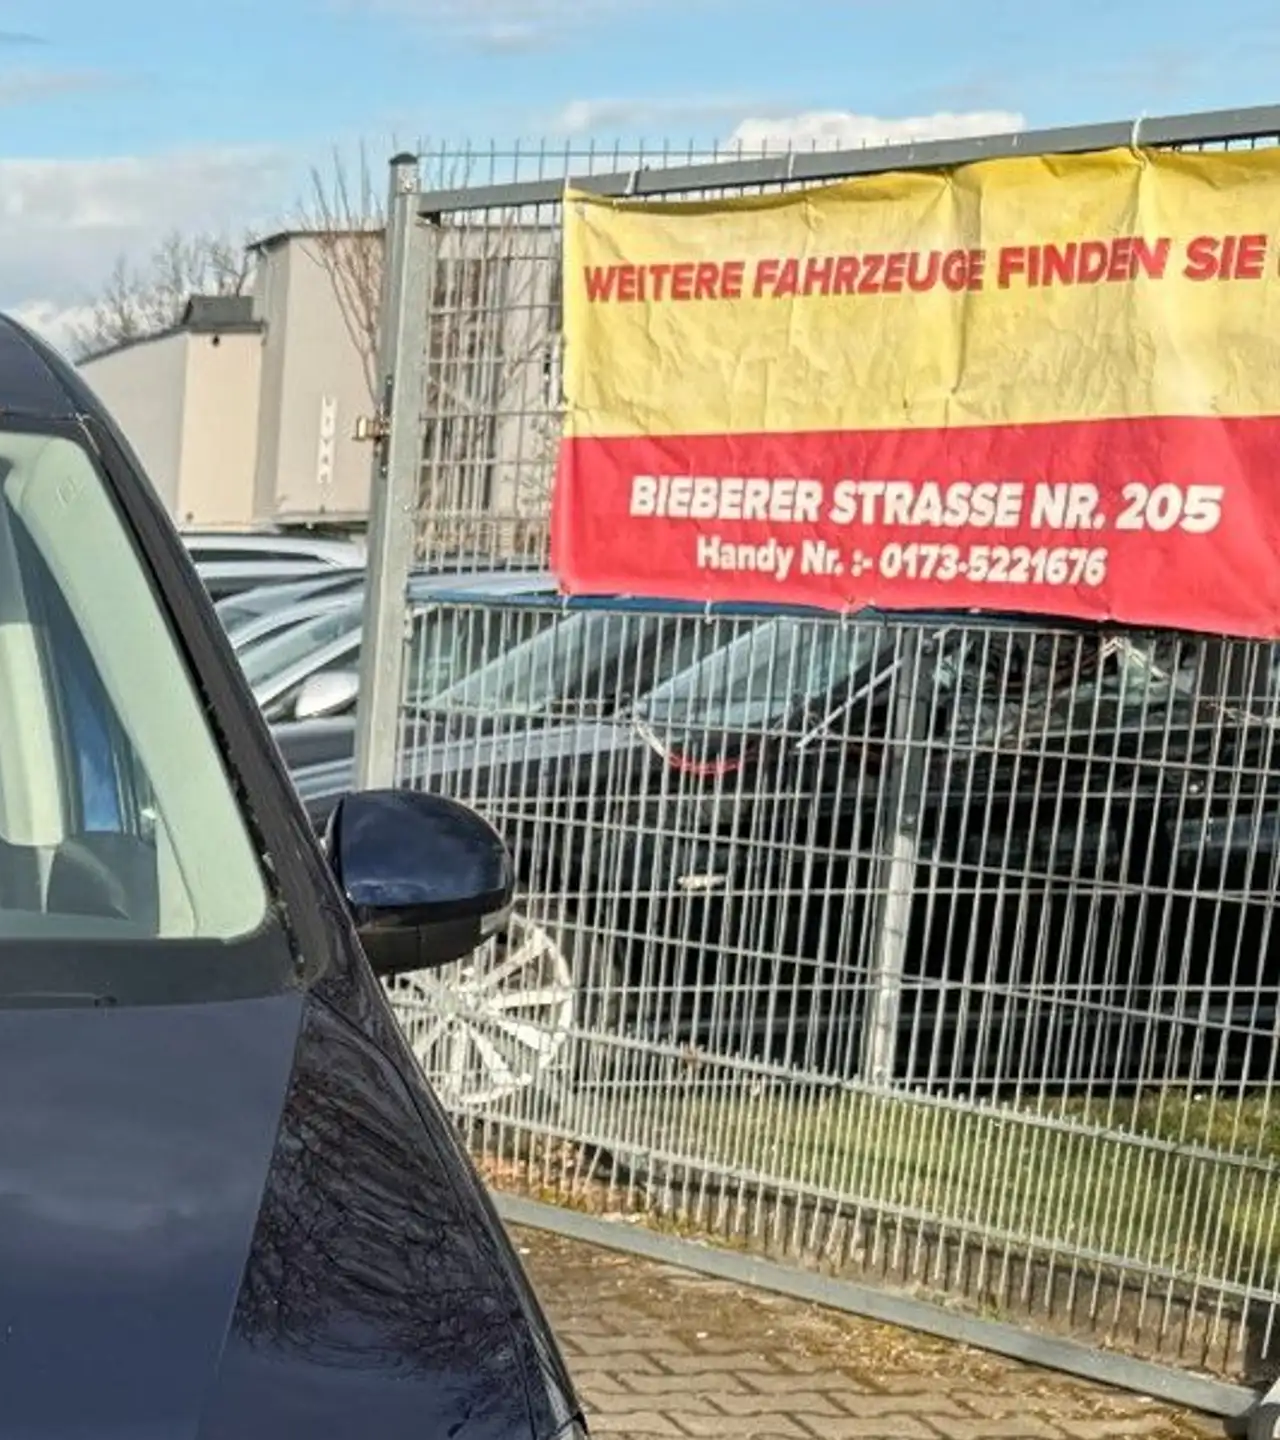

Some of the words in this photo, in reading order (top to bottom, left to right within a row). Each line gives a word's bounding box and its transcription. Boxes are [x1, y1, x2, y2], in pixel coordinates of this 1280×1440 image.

[583, 261, 745, 303] WEITERE
[752, 250, 986, 299] FAHRZEUGE
[997, 236, 1171, 290] FINDEN
[1182, 234, 1268, 281] SIE
[629, 475, 823, 522] BIEBERER
[829, 479, 1024, 528] STRASSE
[1031, 482, 1107, 530] NR.
[1115, 482, 1225, 533] 205
[697, 534, 794, 582] Handy
[800, 540, 844, 575] Nr.
[879, 543, 1109, 586] 0173-5221676
